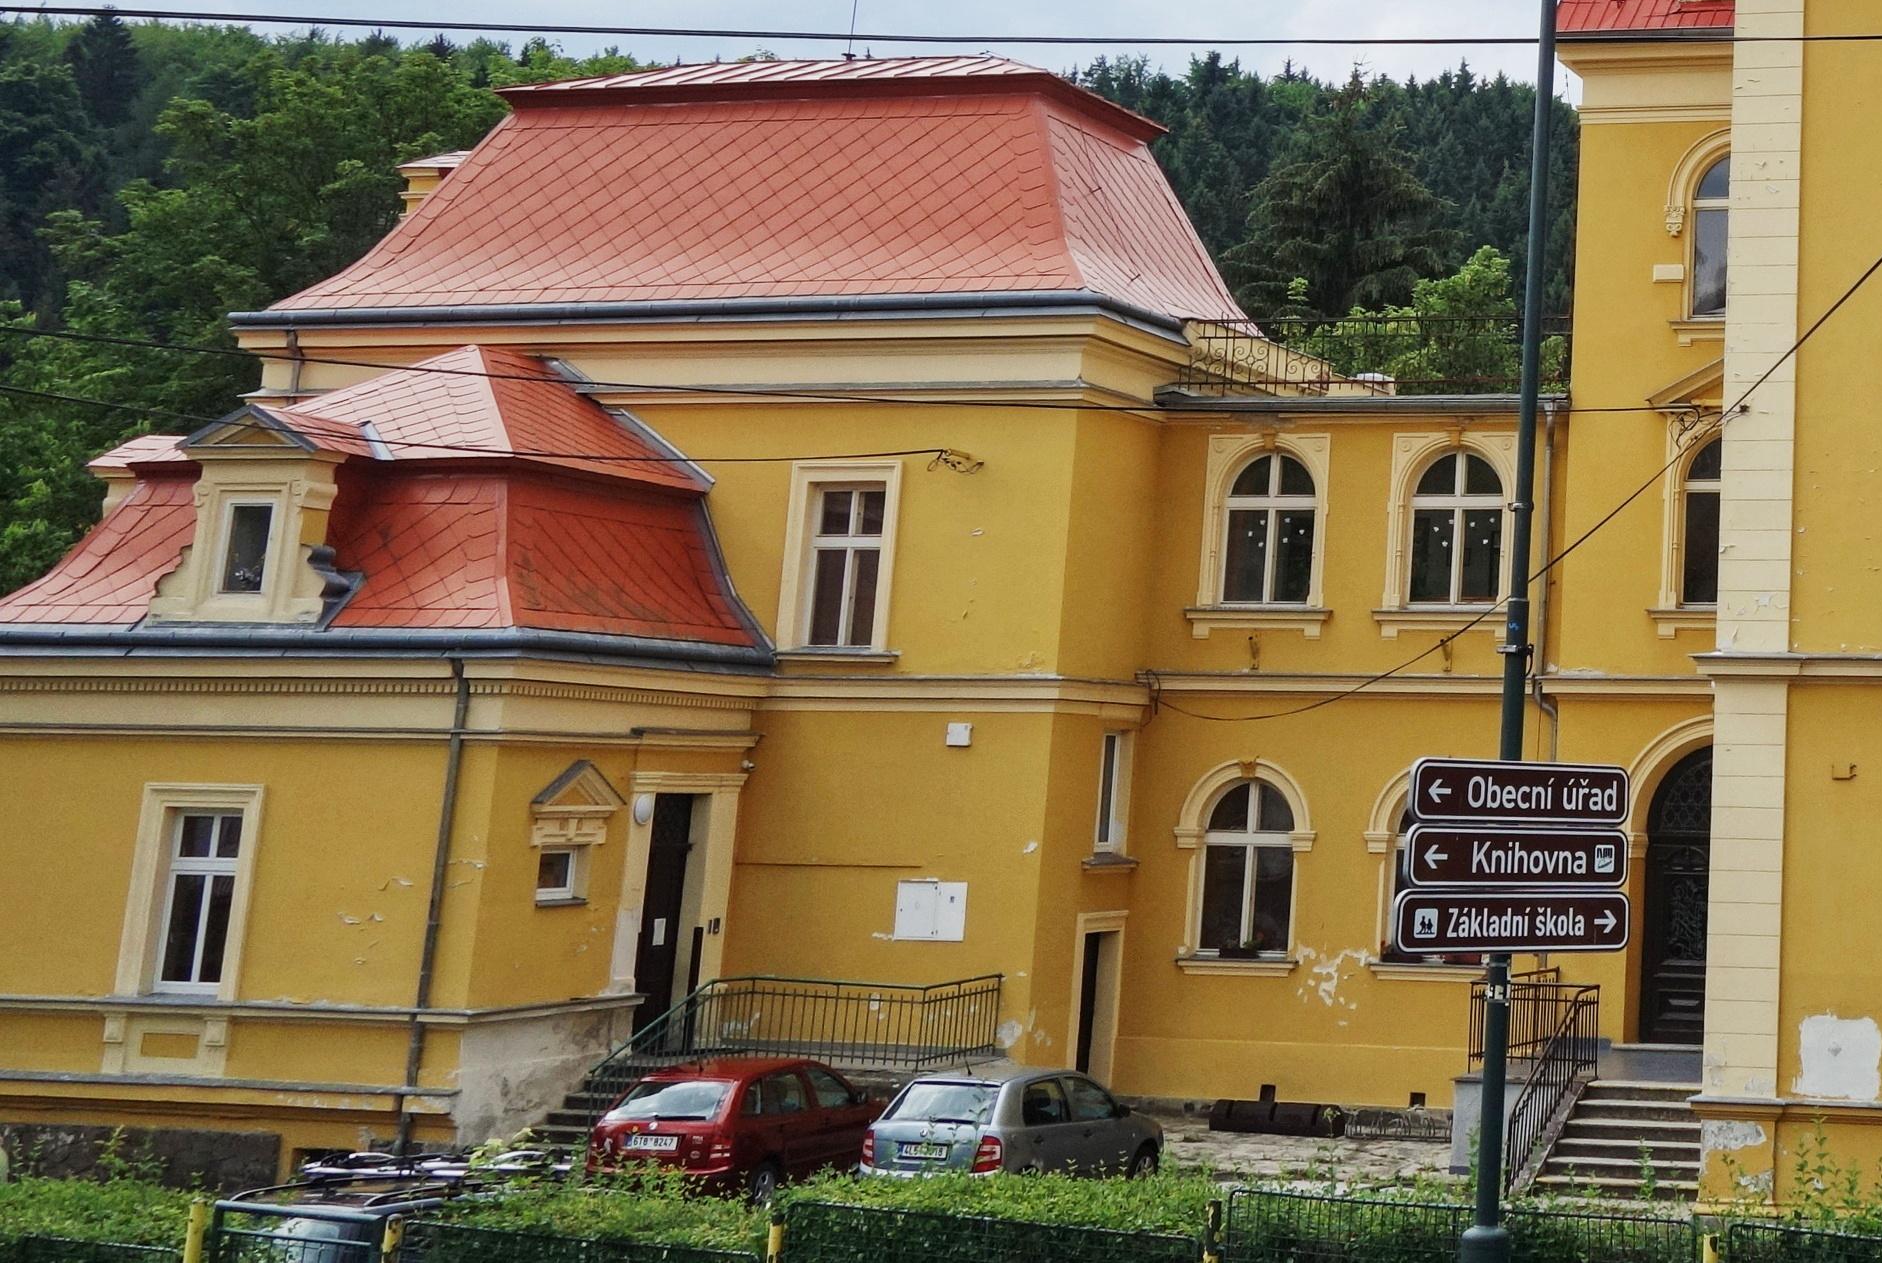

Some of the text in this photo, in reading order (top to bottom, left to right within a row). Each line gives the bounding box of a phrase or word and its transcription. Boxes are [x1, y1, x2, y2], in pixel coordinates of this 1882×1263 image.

[1467, 775, 1618, 812] Obecní úřad
[1471, 840, 1587, 875] Knihovna
[1446, 907, 1585, 938] Základní škola
